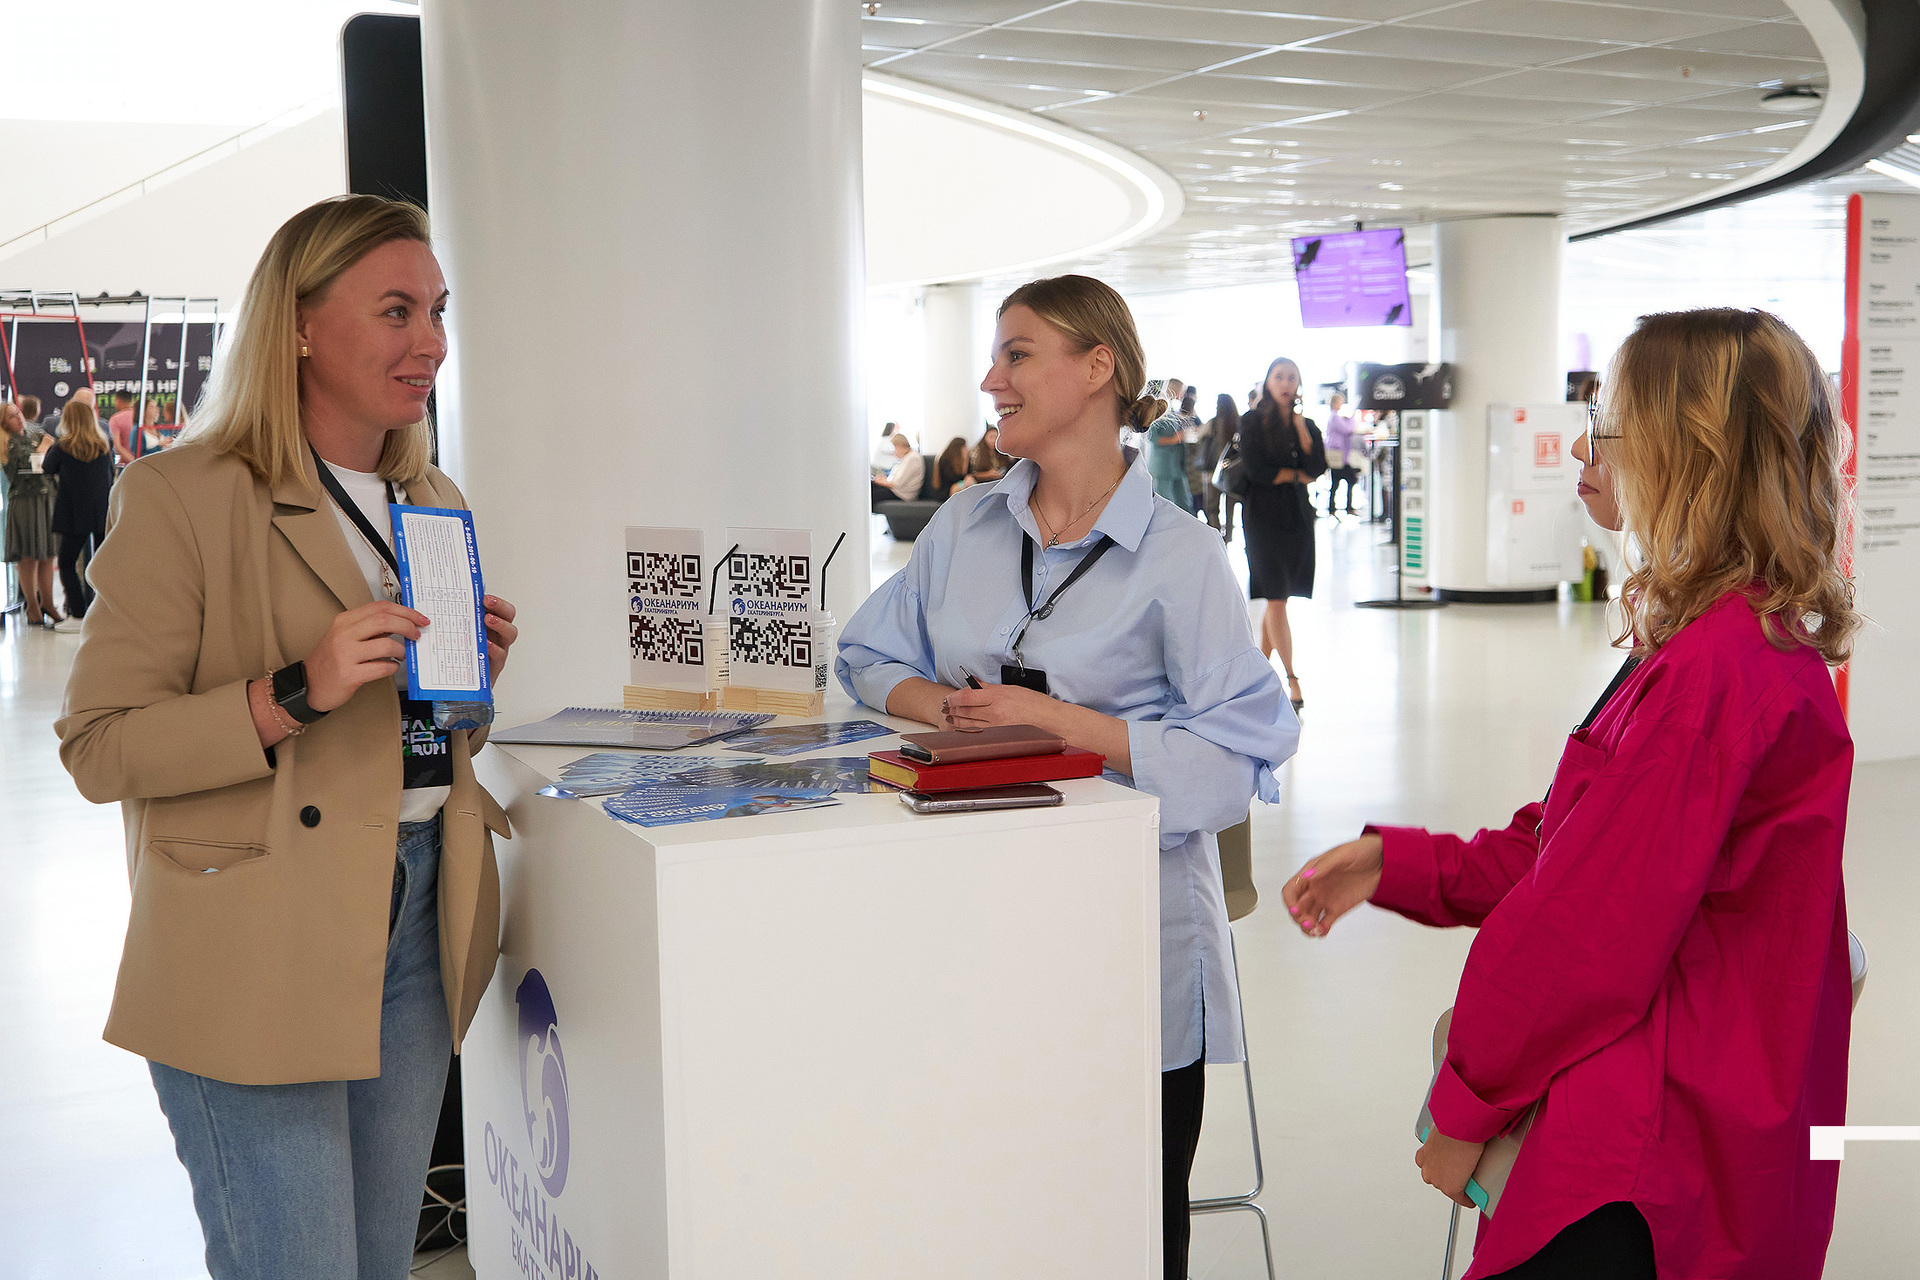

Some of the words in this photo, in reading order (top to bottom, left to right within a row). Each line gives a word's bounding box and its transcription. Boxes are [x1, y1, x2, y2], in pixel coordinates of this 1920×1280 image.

[644, 597, 699, 611] ОКЕАНАРИУМ
[746, 600, 808, 613] ОКЕАНАРИУМ
[484, 1121, 599, 1280] ОКЕАНАРИ
